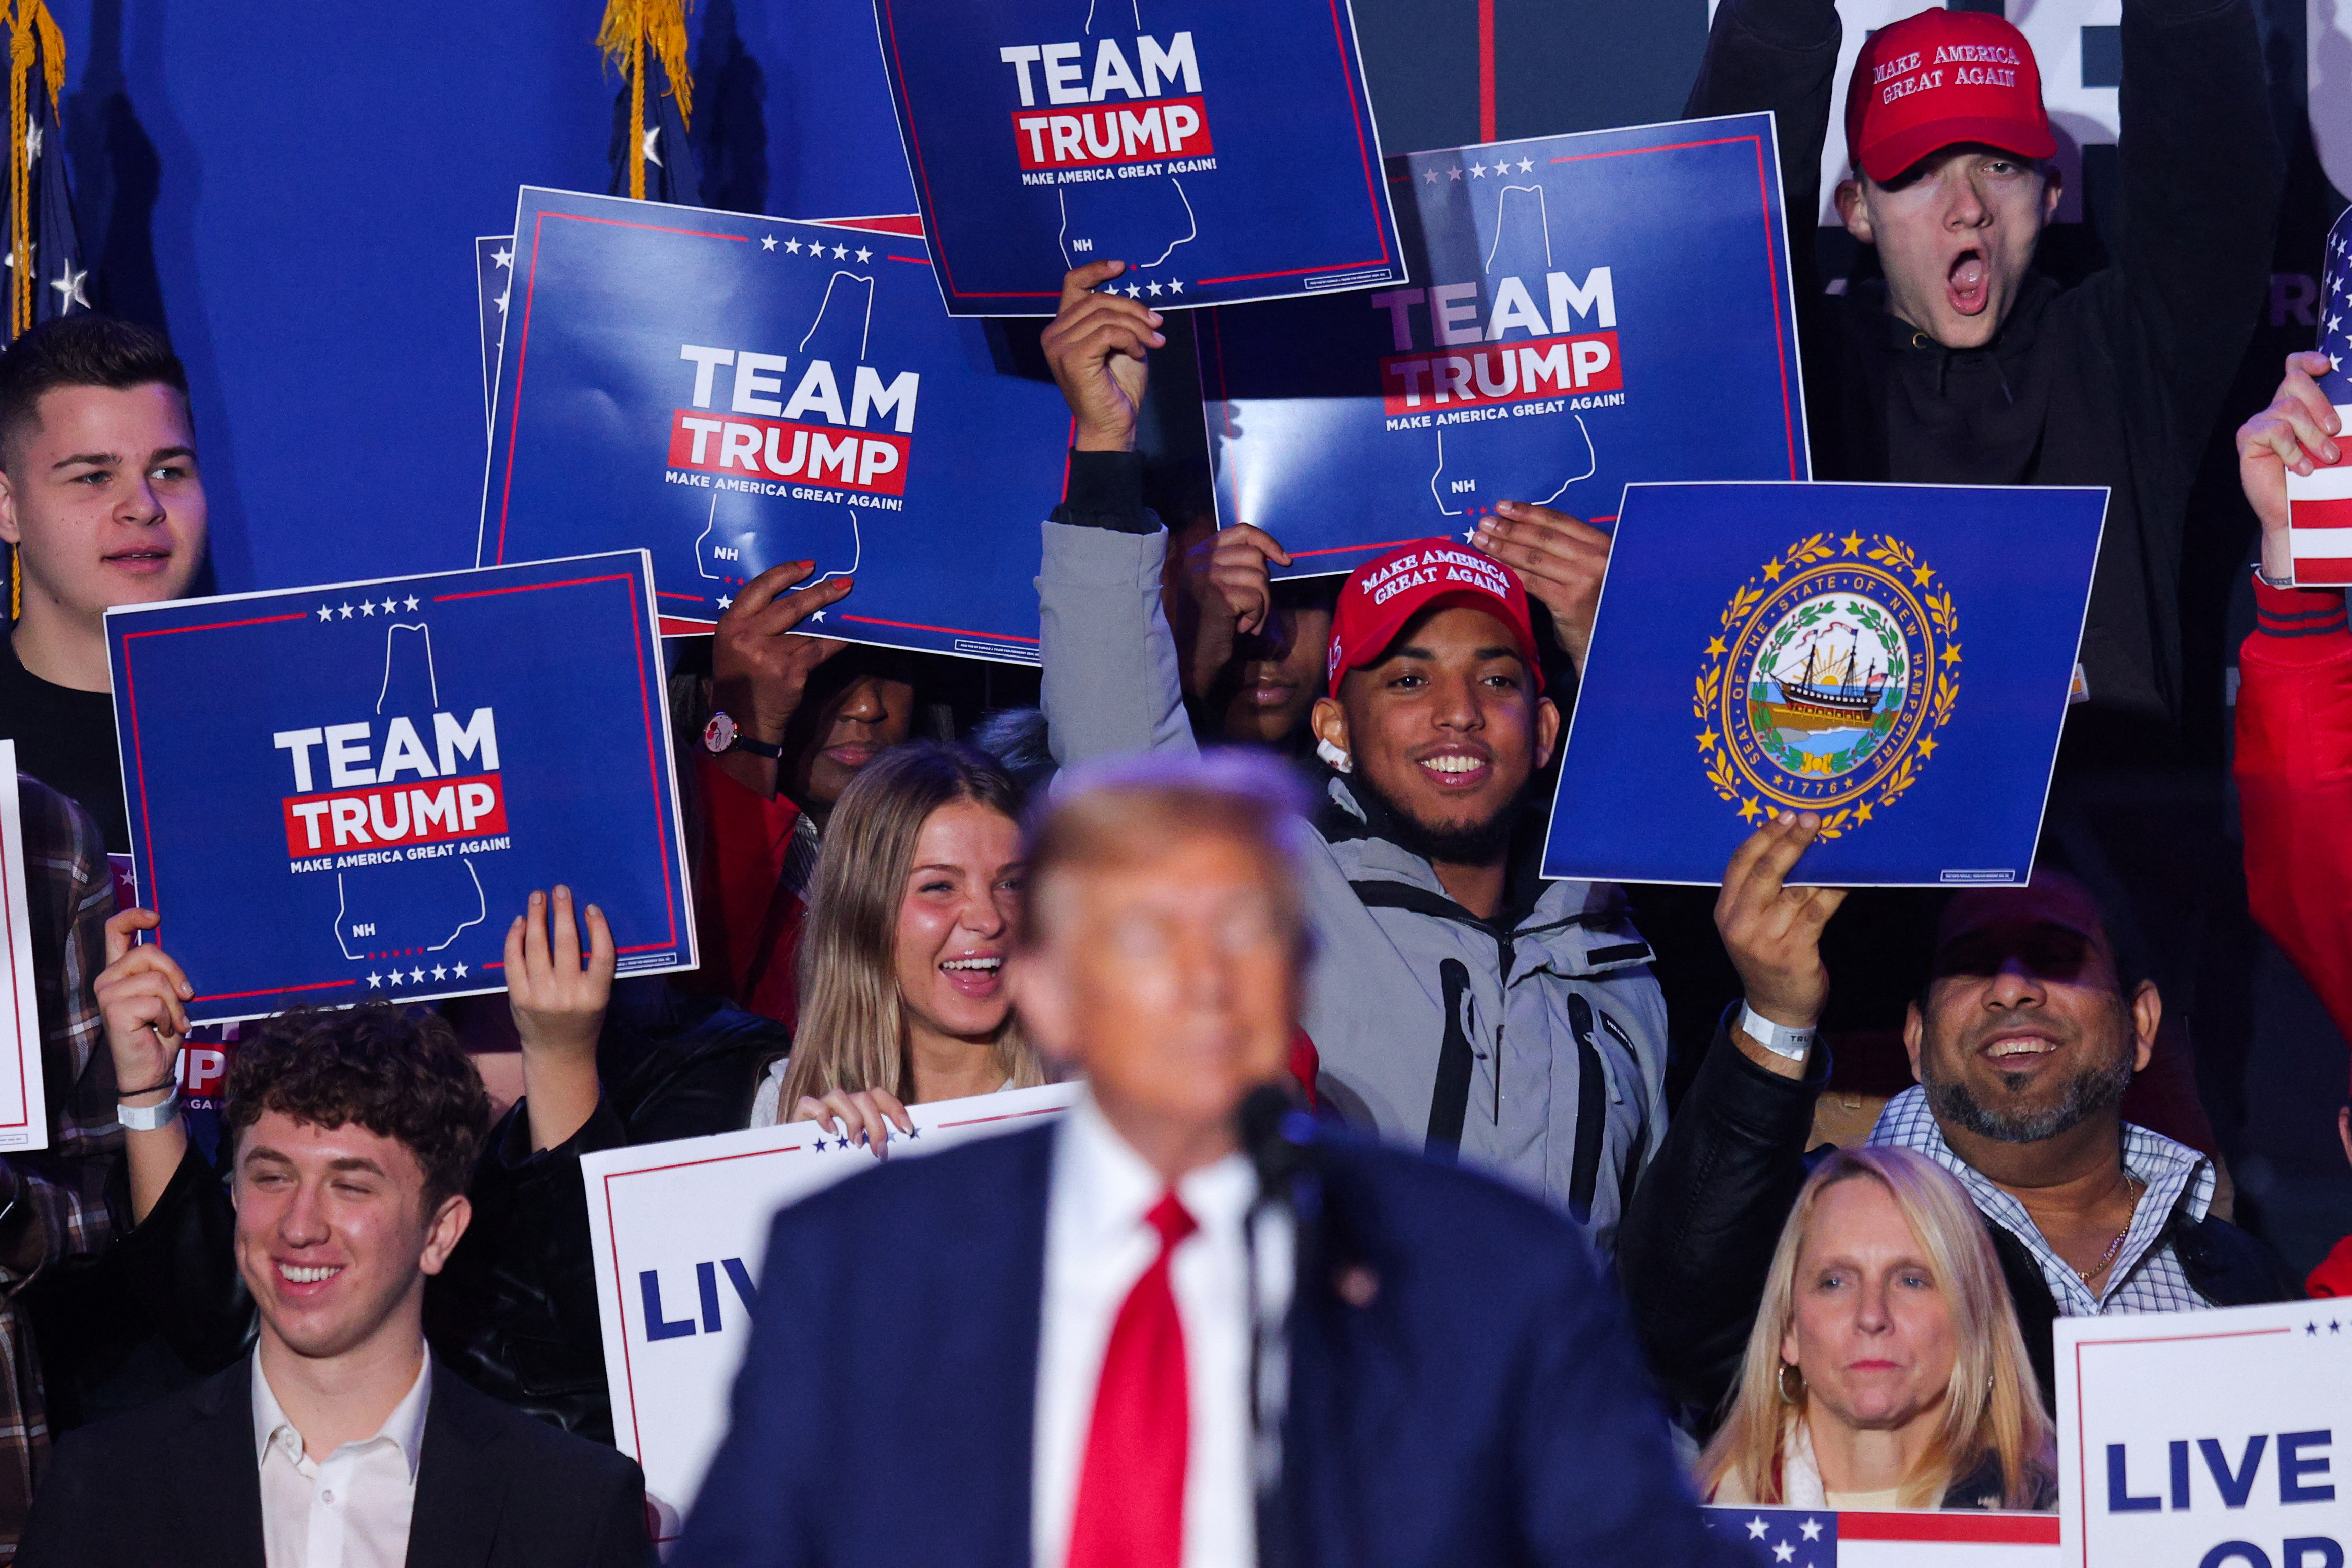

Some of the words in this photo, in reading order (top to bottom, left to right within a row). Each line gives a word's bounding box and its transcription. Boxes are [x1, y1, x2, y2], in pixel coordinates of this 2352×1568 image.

[1000, 32, 1202, 106] TEAM
[1873, 51, 1922, 85] MAKE
[1933, 44, 2021, 65] AMERICA
[1882, 69, 1943, 105] GREAT
[1955, 66, 2015, 87] AGAIN
[1019, 105, 1200, 162] TRUMP
[1022, 173, 1055, 185] MAKE
[1058, 168, 1115, 184] AMERICA
[1118, 164, 1163, 179] GREAT
[1168, 158, 1217, 174] AGAIN!
[1073, 239, 1093, 251] NH
[1371, 266, 1617, 351] TEAM
[680, 344, 920, 433] TEAM
[1390, 340, 1611, 407] TRUMP
[1386, 415, 1432, 431] MAKE
[1436, 407, 1509, 425] AMERICA
[1513, 399, 1565, 416] GREAT
[1570, 393, 1625, 410] AGAIN!
[681, 417, 899, 485] TRUMP
[665, 471, 710, 489] MAKE
[714, 477, 787, 497] AMERICA
[792, 488, 844, 504] GREAT
[847, 494, 903, 512] AGAIN!
[1452, 479, 1476, 493] NH
[714, 546, 739, 562] NH
[1362, 554, 1419, 595] MAKE
[1422, 549, 1510, 588] AMERICA
[1374, 566, 1438, 605] GREAT
[1446, 566, 1506, 599] AGAIN
[1779, 576, 1836, 611] STATE
[1854, 577, 1876, 592] OF
[1890, 597, 1918, 636] NEW
[1743, 622, 1768, 657] THE
[1733, 675, 1745, 699] OF
[1873, 653, 1923, 769] HAMPSHIRE
[274, 707, 500, 792] TEAM
[1735, 718, 1760, 765] SEAL
[1788, 780, 1837, 795] 1776
[292, 783, 495, 849] TRUMP
[291, 858, 333, 873] MAKE
[337, 850, 403, 869] AMERICA
[407, 843, 455, 860] GREAT
[460, 837, 511, 854] AGAIN!
[353, 923, 376, 937] NH
[2107, 1430, 2336, 1513] LIVE
